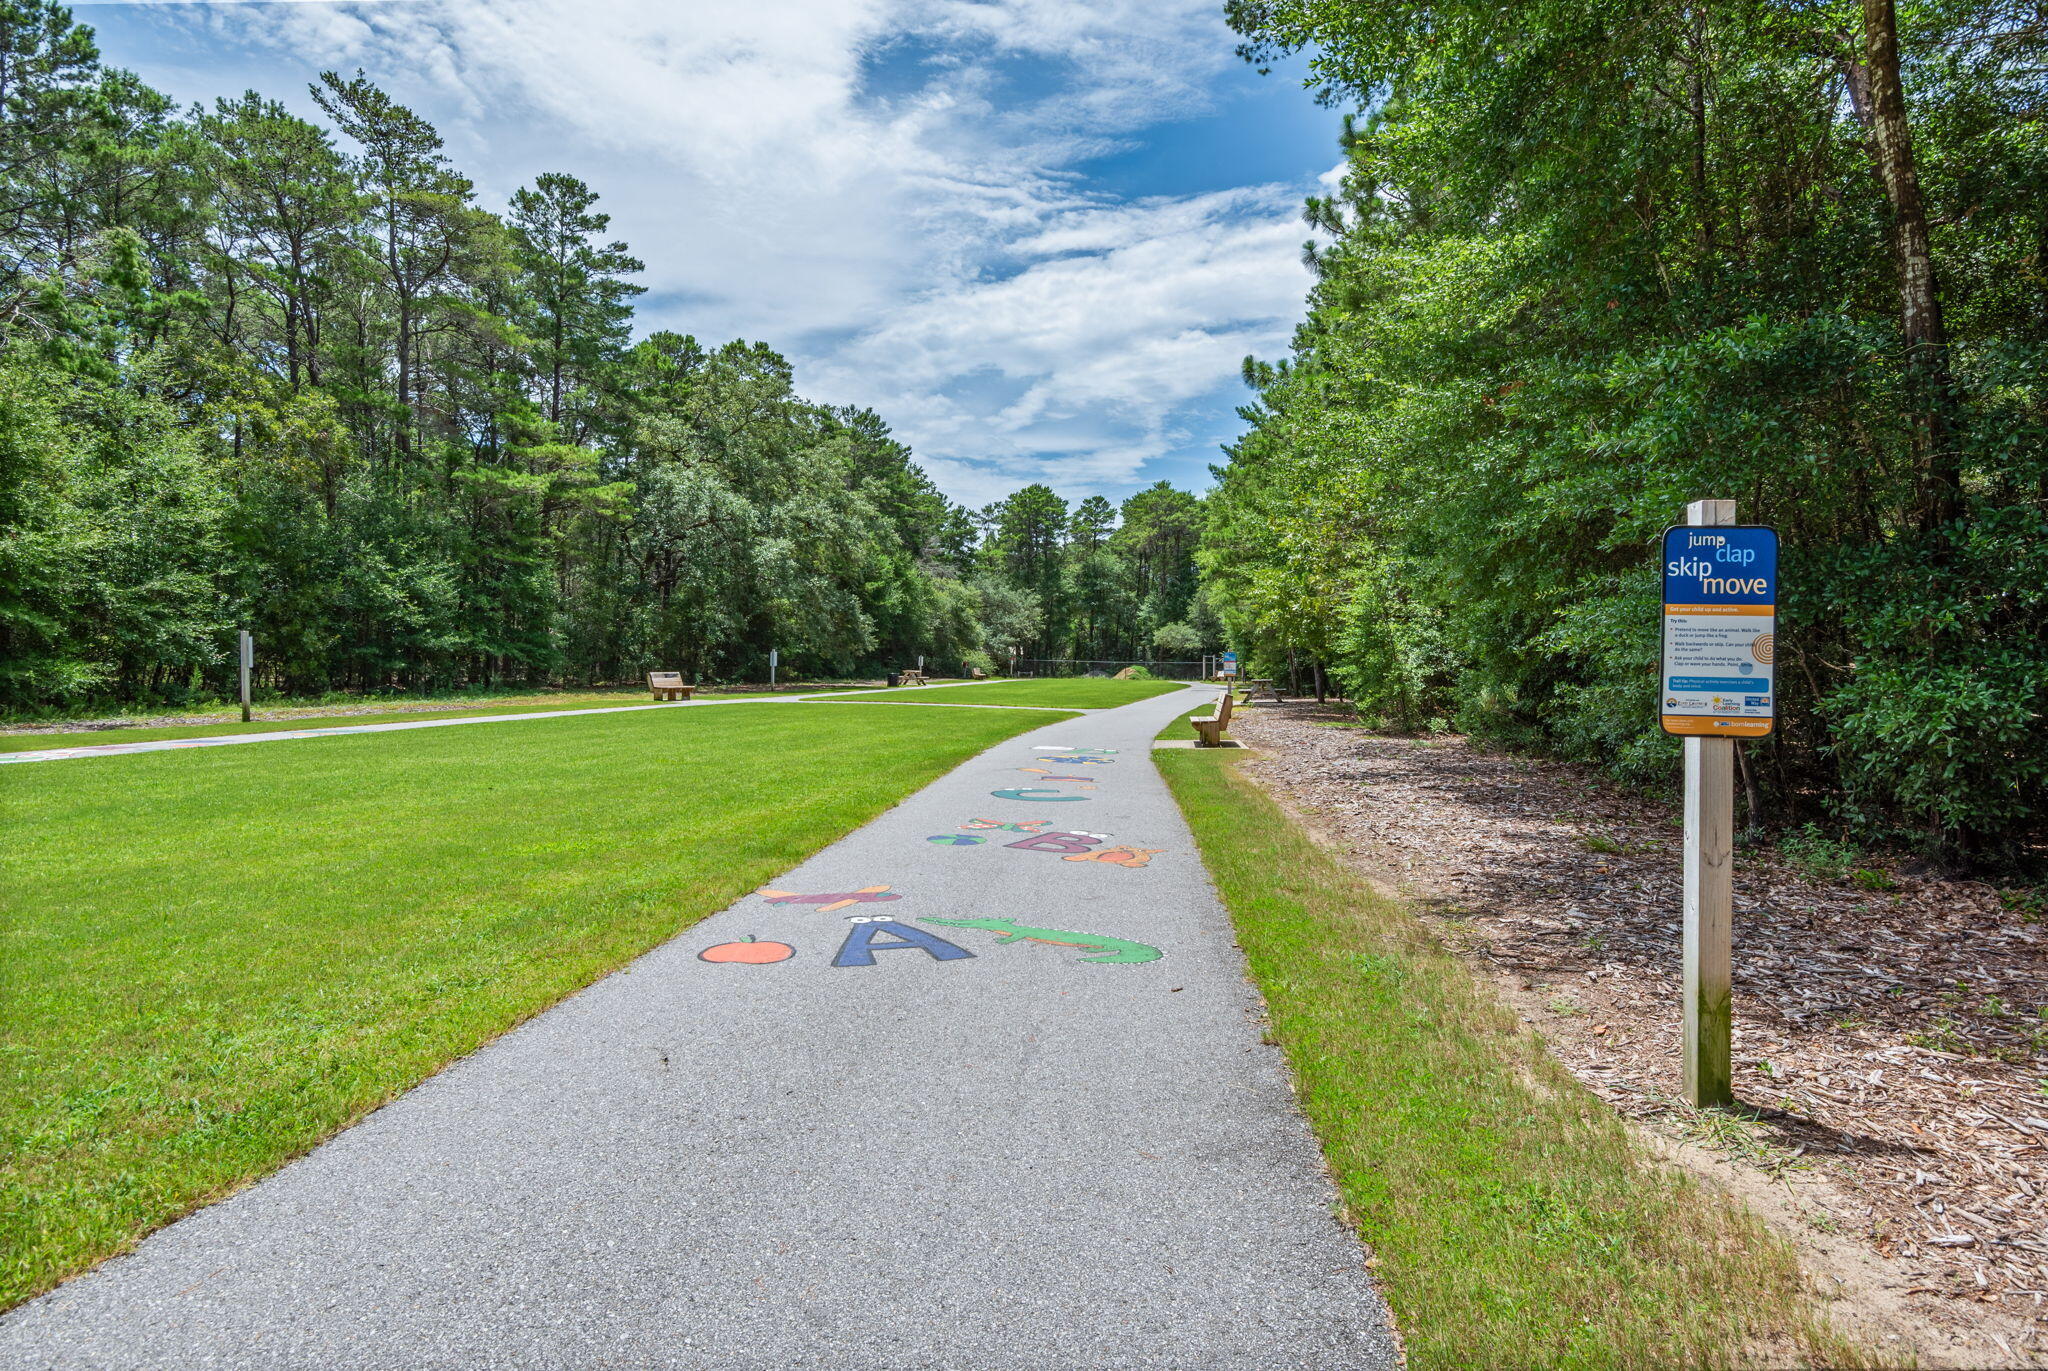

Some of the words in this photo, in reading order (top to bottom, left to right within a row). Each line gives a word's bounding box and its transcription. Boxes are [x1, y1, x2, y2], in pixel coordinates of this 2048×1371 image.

[1689, 532, 1725, 549] jump
[1716, 544, 1755, 567] clap
[1668, 557, 1712, 581] skip
[1704, 578, 1767, 594] move
[1003, 832, 1103, 854] B
[830, 918, 977, 967] A
